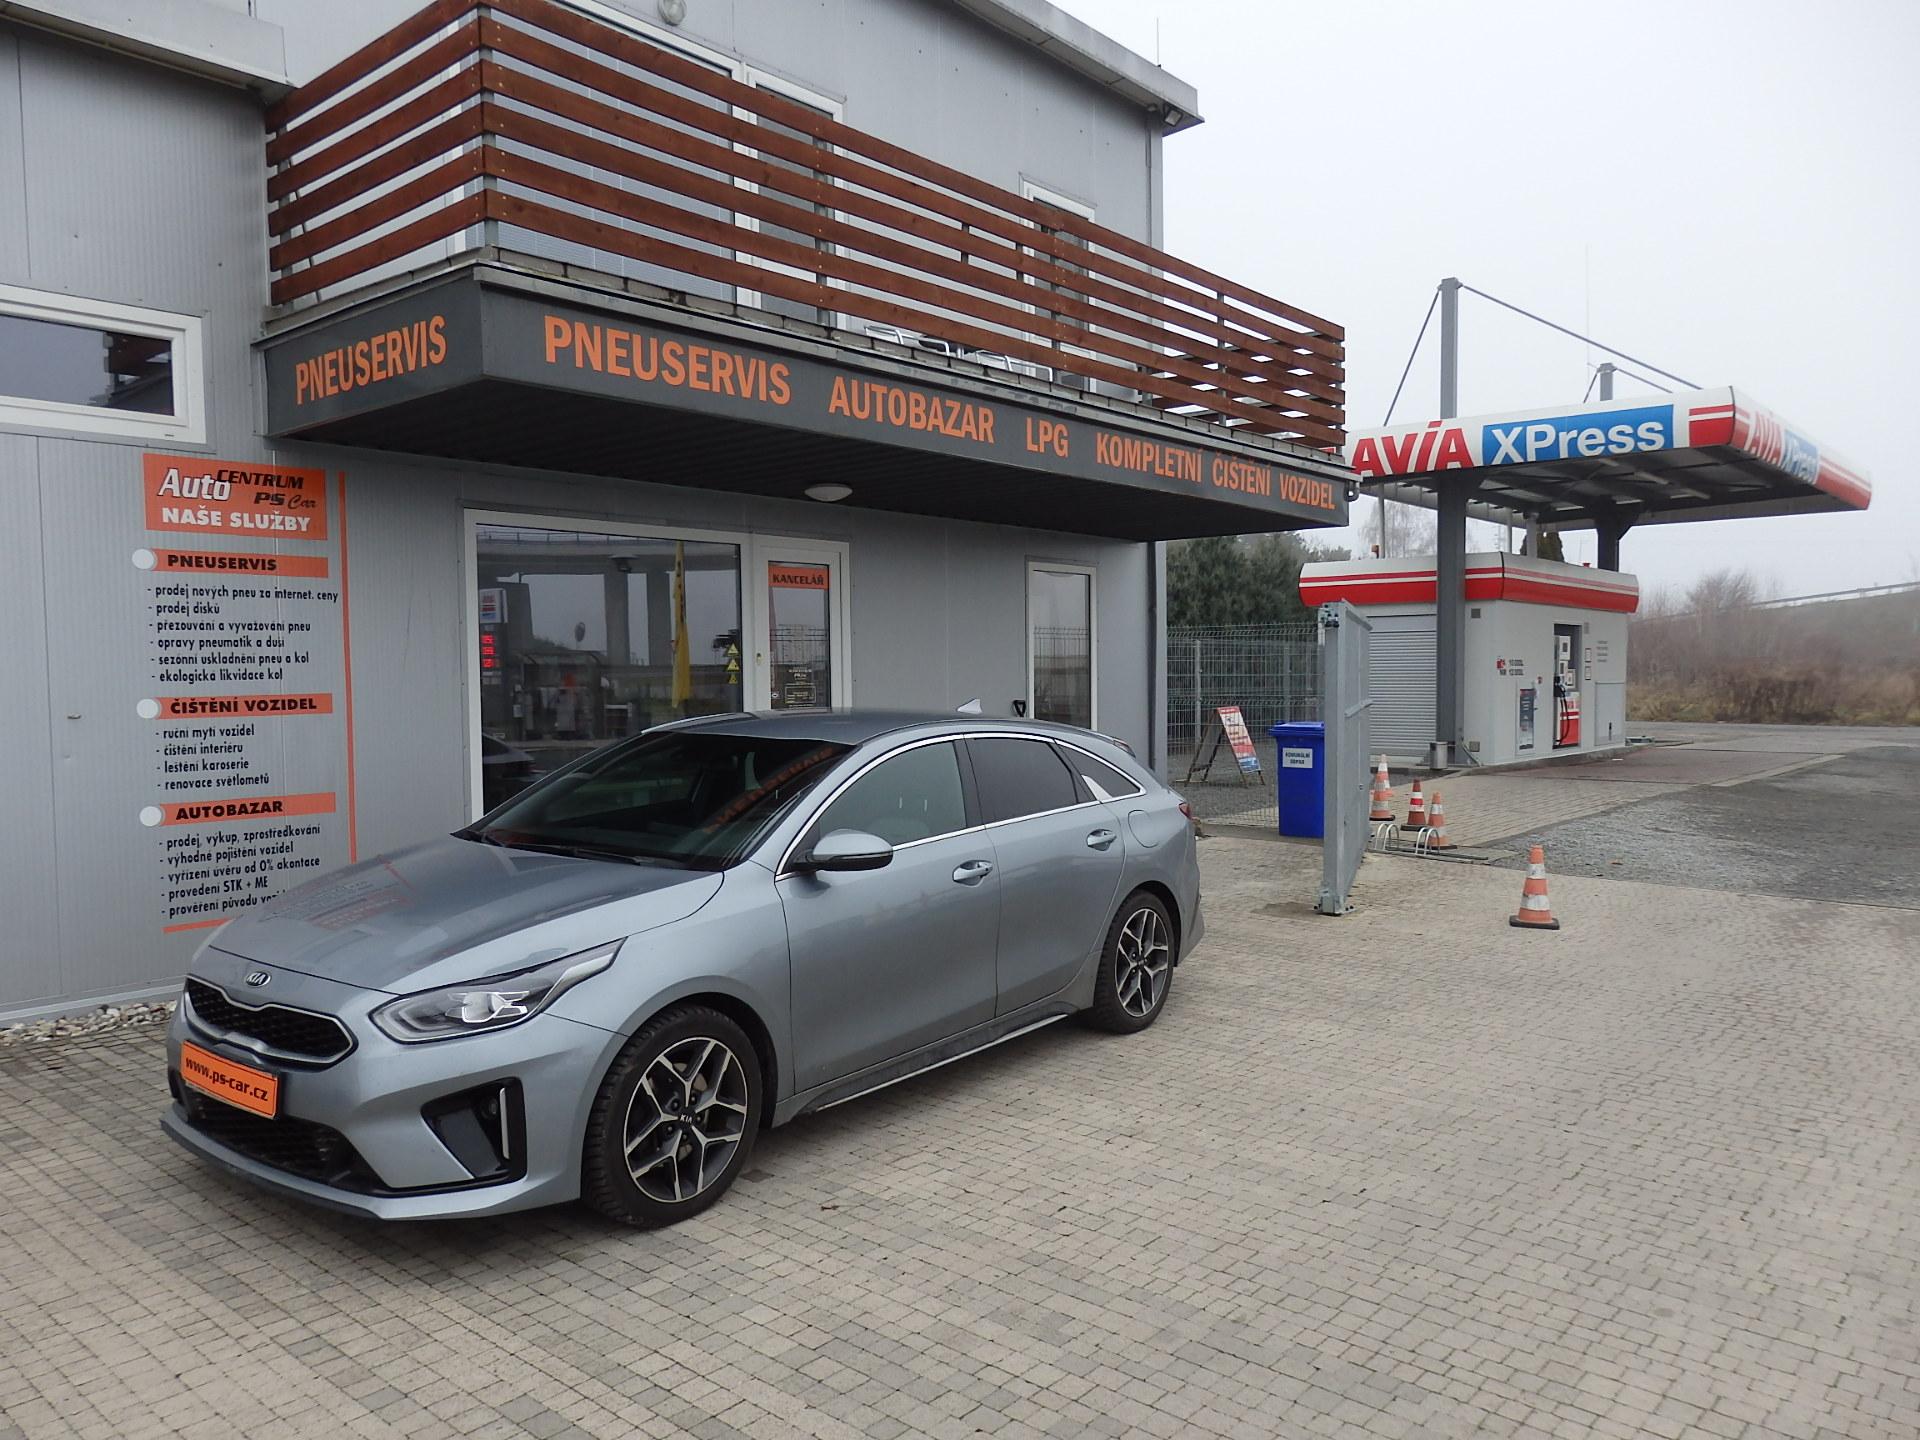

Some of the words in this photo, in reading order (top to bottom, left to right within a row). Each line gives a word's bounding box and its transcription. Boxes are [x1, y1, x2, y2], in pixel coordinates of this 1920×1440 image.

[296, 315, 448, 406] PNEUSERVIS
[544, 315, 792, 406] PNEUSERVIS
[828, 376, 995, 444] AUTOBAZAR
[1026, 417, 1069, 458] LPG
[1096, 431, 1202, 483] KOMPLETNÍ
[1212, 453, 1271, 497] ČIŠTĚNÍ
[1279, 474, 1335, 510] VOZIDEL
[1490, 419, 1665, 465] XPress
[157, 467, 231, 501] Auto
[217, 469, 304, 489] CENTRUM
[254, 492, 285, 505] PS
[288, 494, 317, 509] Car
[163, 505, 222, 526] NAŠE
[230, 511, 310, 531] SLUŽBY
[168, 555, 277, 570] PNEUSERVIS
[156, 584, 189, 599] prodej
[192, 585, 229, 599] nových
[233, 588, 256, 599] pneu
[260, 590, 271, 598] za
[317, 591, 339, 603] ceny
[157, 603, 190, 617] prodej
[157, 620, 214, 634] přezouvání
[219, 623, 225, 631] a
[288, 622, 311, 632] pneu
[158, 639, 195, 650] opravy
[199, 635, 252, 650] pneumatik
[256, 639, 262, 647] a
[259, 656, 282, 668] pneu
[285, 655, 291, 663] a
[294, 652, 309, 663] kol
[220, 669, 264, 681] likvidace
[268, 669, 282, 680] kol
[171, 697, 238, 714] ČIŠTĚNÍ
[244, 698, 316, 711] VOZIDEL
[163, 726, 189, 739] ruční
[219, 724, 254, 737] vozidel
[202, 757, 249, 771] karoserie
[165, 778, 212, 790] renovace
[216, 772, 269, 787] světlometů
[176, 801, 282, 820] AUTOBAZAR
[243, 824, 321, 841] zprostředkování
[168, 853, 212, 867] výhodné
[216, 846, 256, 863] pojištění
[260, 841, 294, 855] vozidel
[245, 862, 256, 873] od
[260, 860, 273, 871] 0%
[277, 857, 320, 869] akontace
[169, 885, 220, 901] provedení
[223, 877, 242, 892] STK
[255, 875, 268, 888] ME
[247, 973, 266, 984] KIA
[185, 1056, 268, 1102] www.ps-car.cz
[680, 1114, 693, 1123] KIA
